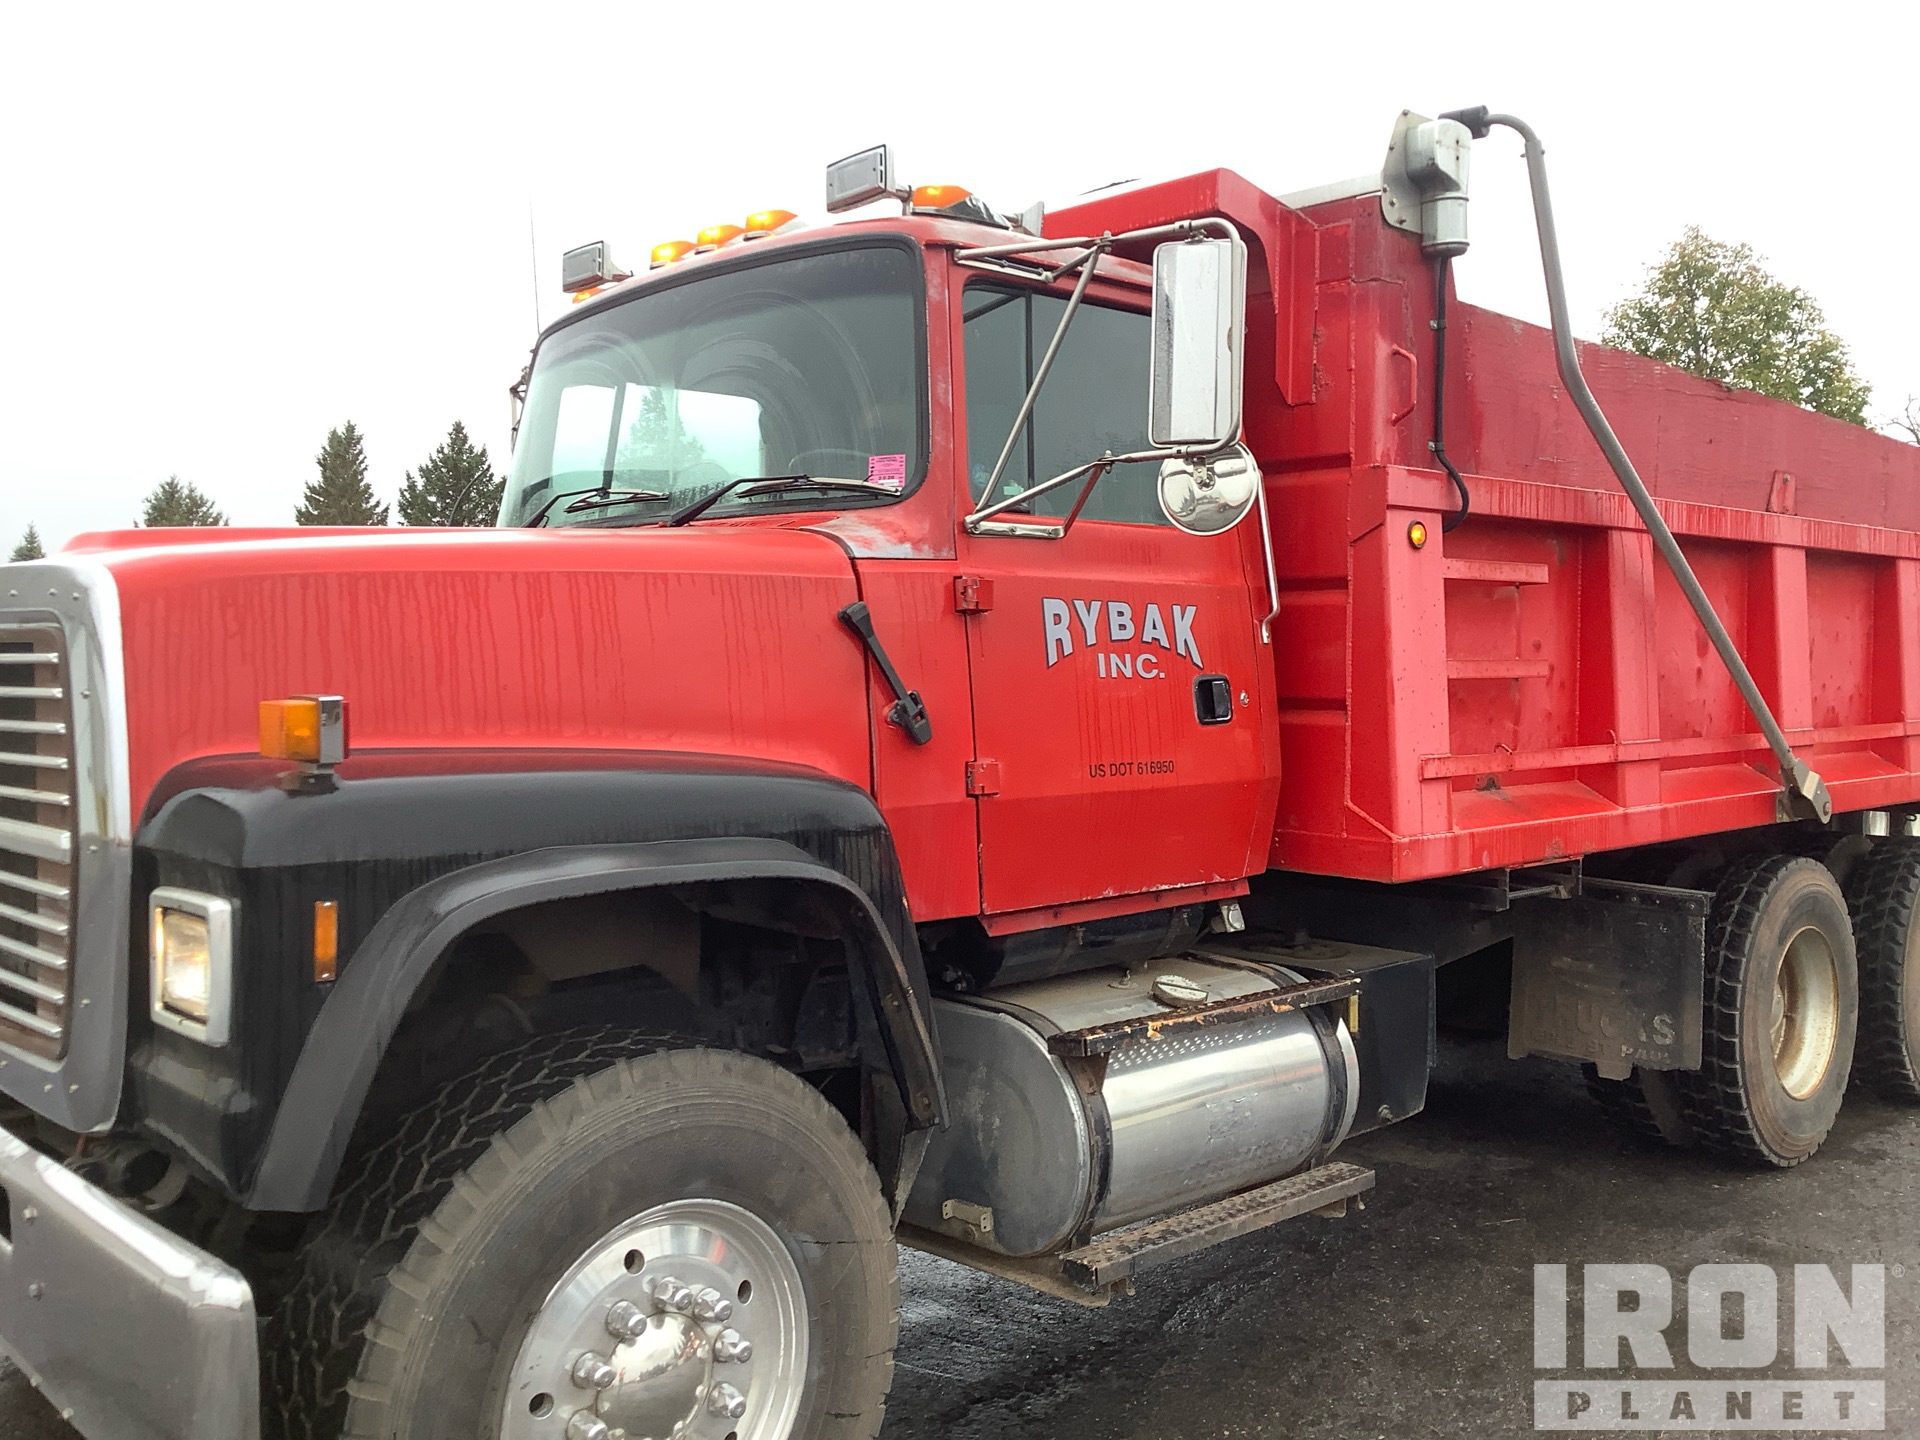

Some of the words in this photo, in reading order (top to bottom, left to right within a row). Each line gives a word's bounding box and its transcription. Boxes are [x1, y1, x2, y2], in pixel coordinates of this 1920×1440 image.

[1042, 597, 1203, 669] RYBAK
[1098, 652, 1166, 679] INC.
[1089, 763, 1106, 778] US
[1109, 761, 1134, 777] DOT
[1137, 760, 1174, 775] 616950
